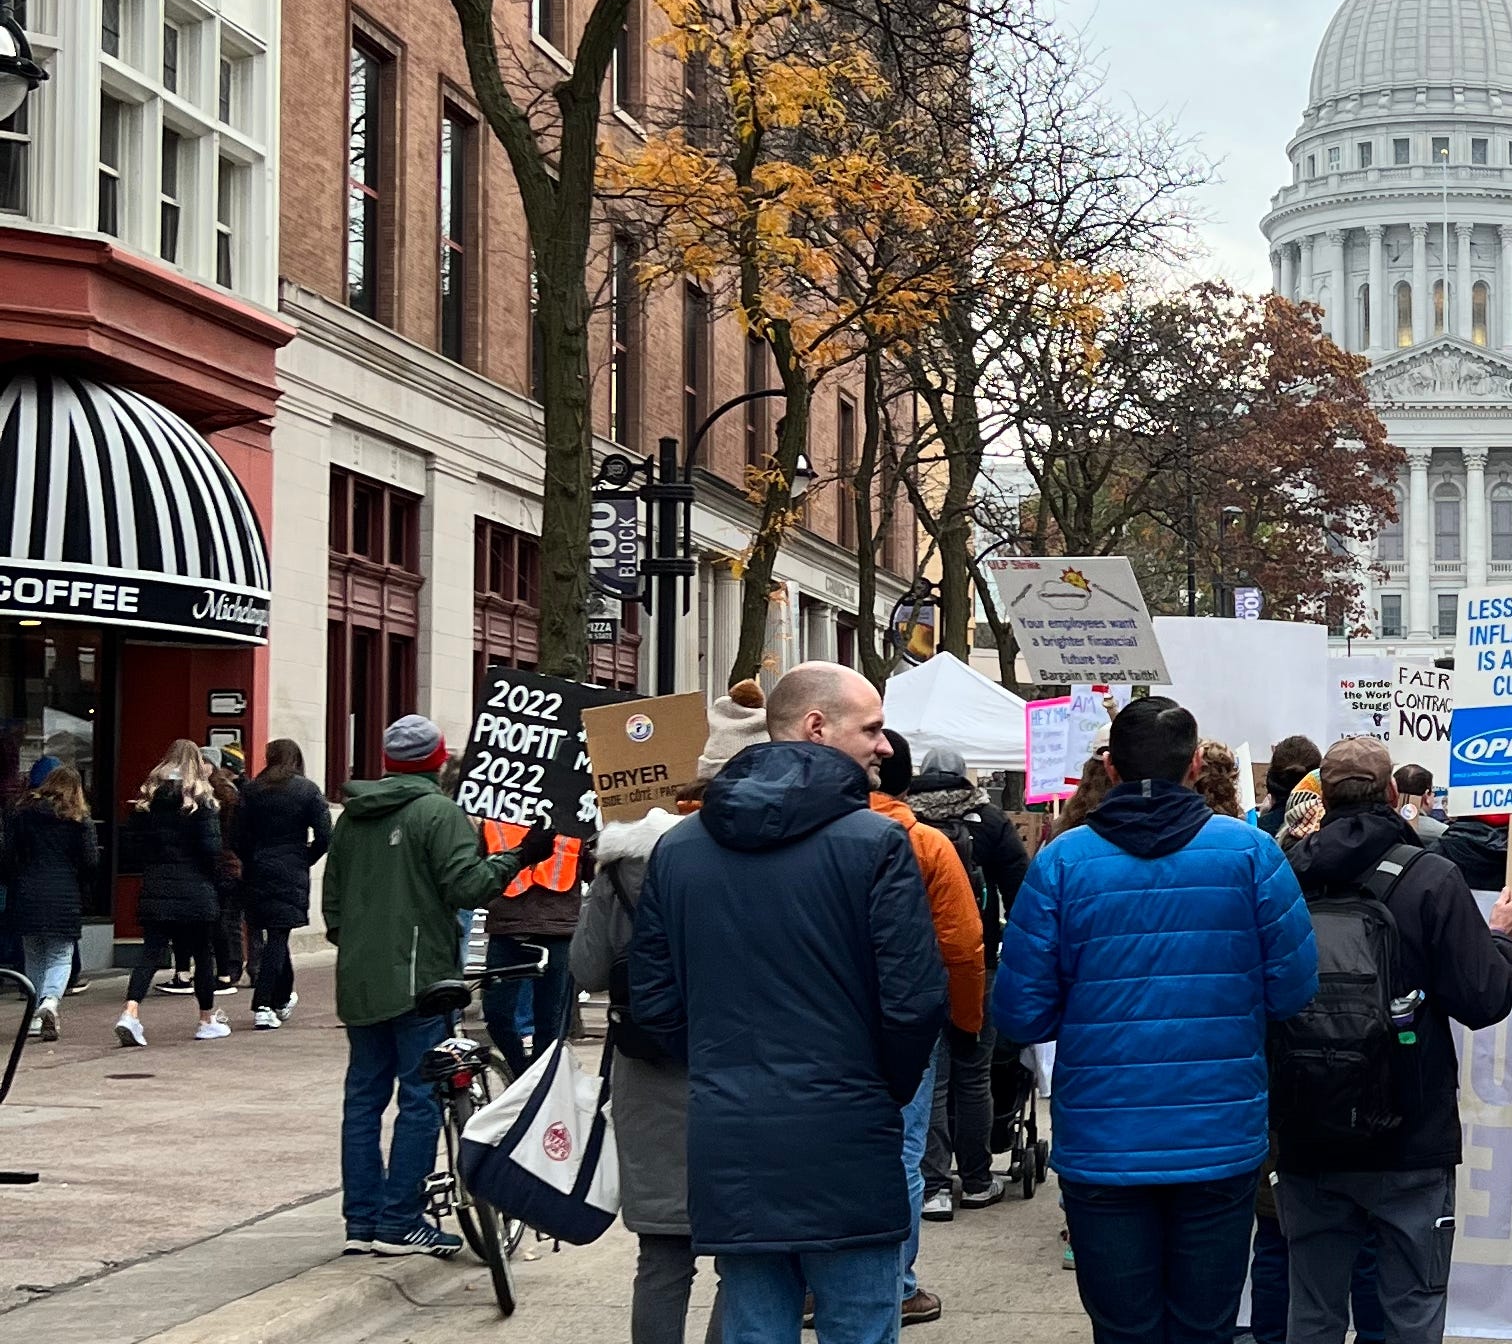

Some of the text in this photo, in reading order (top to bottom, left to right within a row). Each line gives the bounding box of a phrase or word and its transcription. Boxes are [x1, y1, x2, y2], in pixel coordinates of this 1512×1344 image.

[618, 516, 637, 578] BLOCK
[1236, 594, 1245, 618] BLOC
[1243, 587, 1260, 620] 100
[1019, 618, 1138, 632] Your employees want
[1032, 635, 1138, 650] a brighter financial
[1061, 653, 1095, 665] future
[1478, 650, 1496, 671] IS
[1040, 669, 1158, 683] Bargain in good faith!
[1340, 679, 1392, 689] No Borde
[1399, 667, 1451, 690] FAIR
[487, 679, 563, 721] 2022
[1344, 691, 1362, 699] the
[1394, 690, 1453, 713] CONTRAC
[473, 712, 569, 761] PROFIT
[1399, 709, 1452, 742] NOW
[467, 751, 546, 795] 2022
[597, 764, 669, 791] DRYER
[456, 780, 554, 831] RAISES
